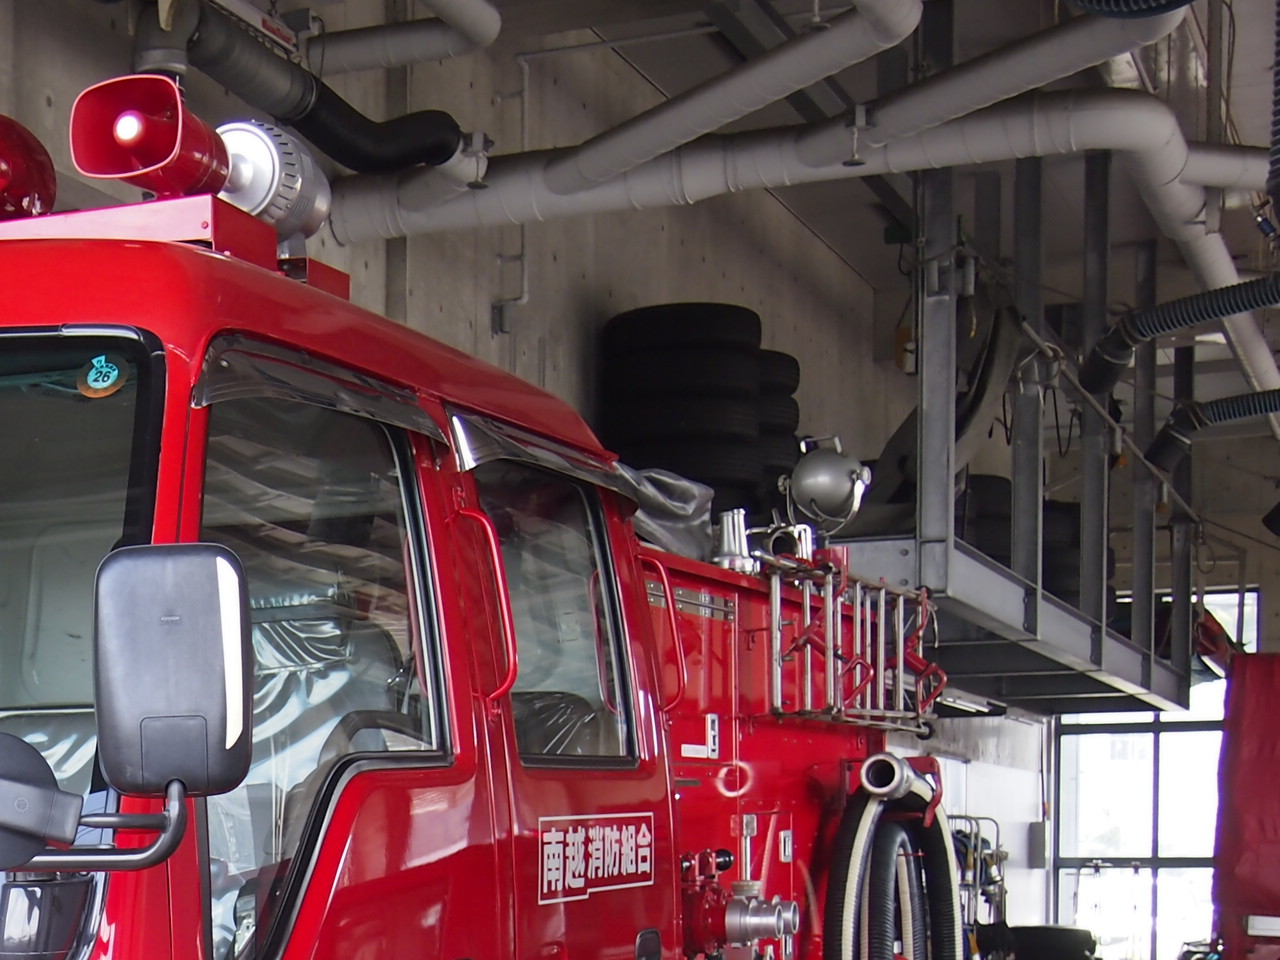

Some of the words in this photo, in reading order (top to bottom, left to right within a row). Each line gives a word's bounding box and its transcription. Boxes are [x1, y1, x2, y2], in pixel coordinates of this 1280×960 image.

[92, 371, 111, 383] 26
[543, 823, 651, 893] 南越消防組合
